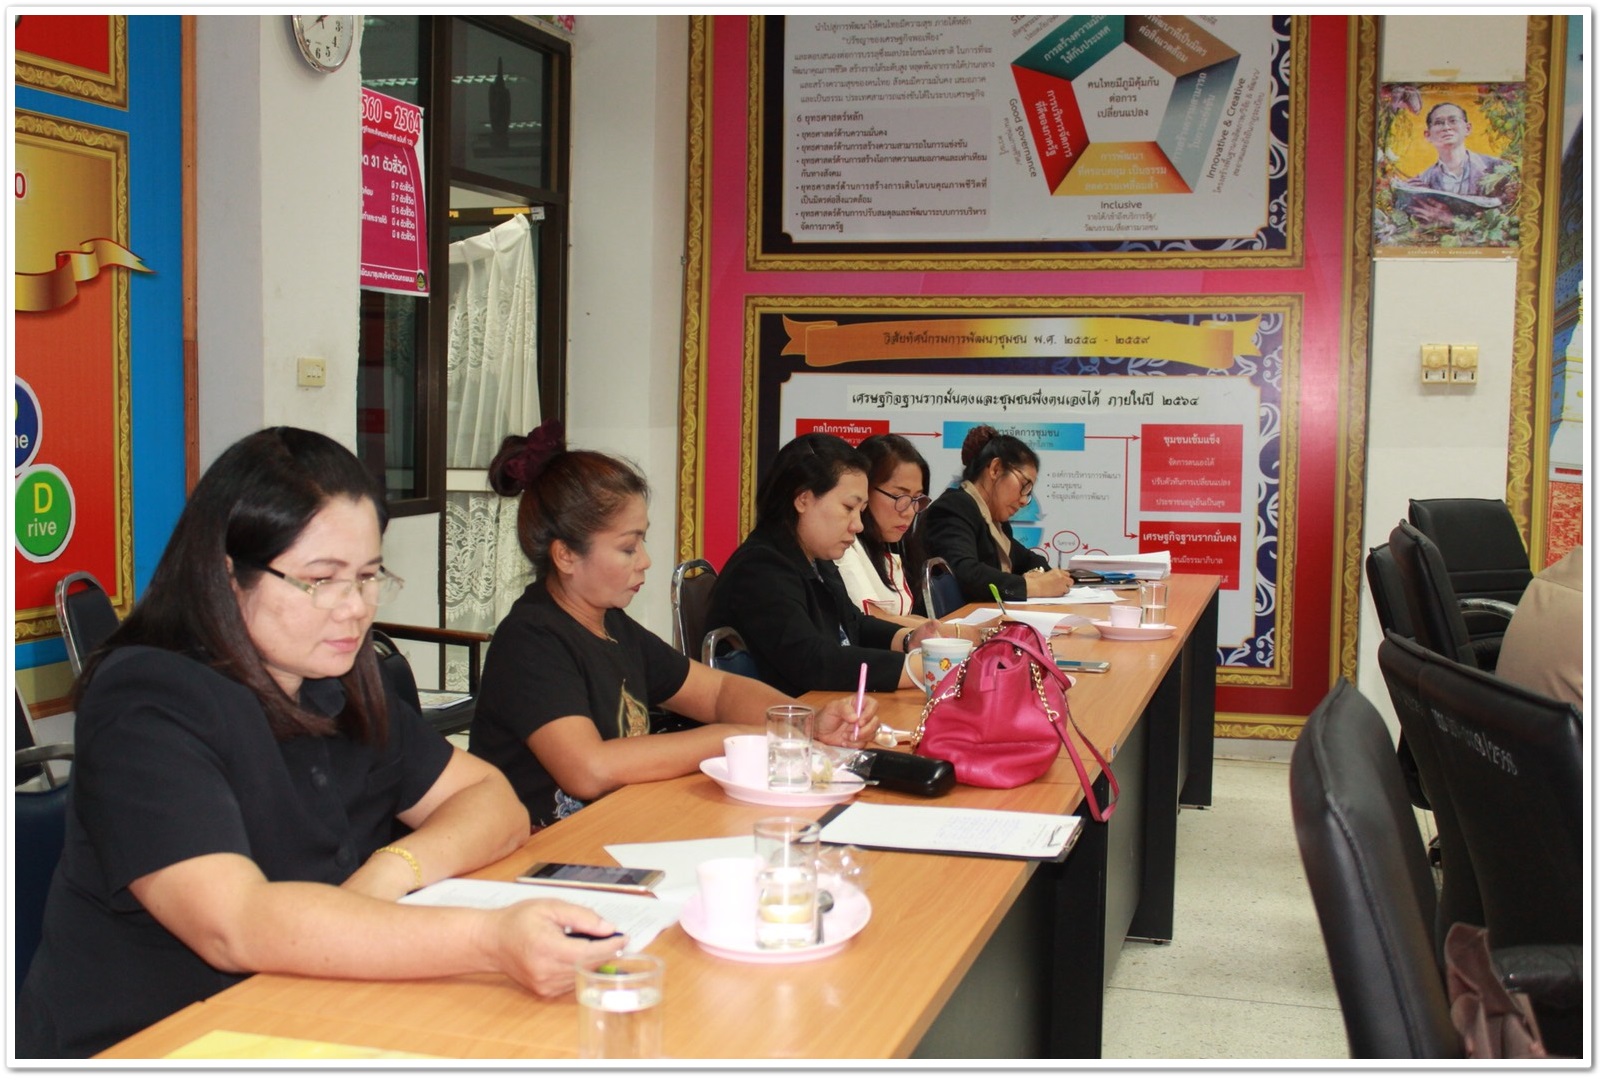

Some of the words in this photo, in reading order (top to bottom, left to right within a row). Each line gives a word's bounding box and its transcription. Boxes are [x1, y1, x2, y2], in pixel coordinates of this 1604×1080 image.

[1227, 77, 1246, 117] Creative
[804, 111, 864, 125] ยุทธศาสตร์หลัก
[1009, 98, 1023, 124] Good
[393, 105, 420, 135] 2564
[1223, 119, 1232, 128] &
[801, 125, 888, 141] ยุทธศาสตร์ด้านความมั่นคง
[1015, 125, 1037, 178] governance
[1206, 129, 1229, 179] Innovative
[371, 154, 380, 168] 31
[801, 168, 842, 178] กันทางสังคม
[1100, 200, 1143, 210] Inclusive
[801, 221, 844, 233] จัดการภาครัฐ
[1034, 335, 1057, 345] พ.ศ.
[852, 388, 1102, 411] เศรษฐกิจฐานรากมั่นคงและชุมชนพึ่งตนเองได้
[1107, 389, 1155, 408] ภายในปี
[1162, 395, 1200, 406] ๒๕๖๔
[813, 422, 872, 434] กลไกการพัฒนา
[1163, 433, 1221, 448] ชุมชนเข้มแข็ง
[34, 483, 53, 514] D
[27, 518, 57, 537] rive
[1142, 529, 1237, 546] เศรษฐกิจฐานรากมั่นคง
